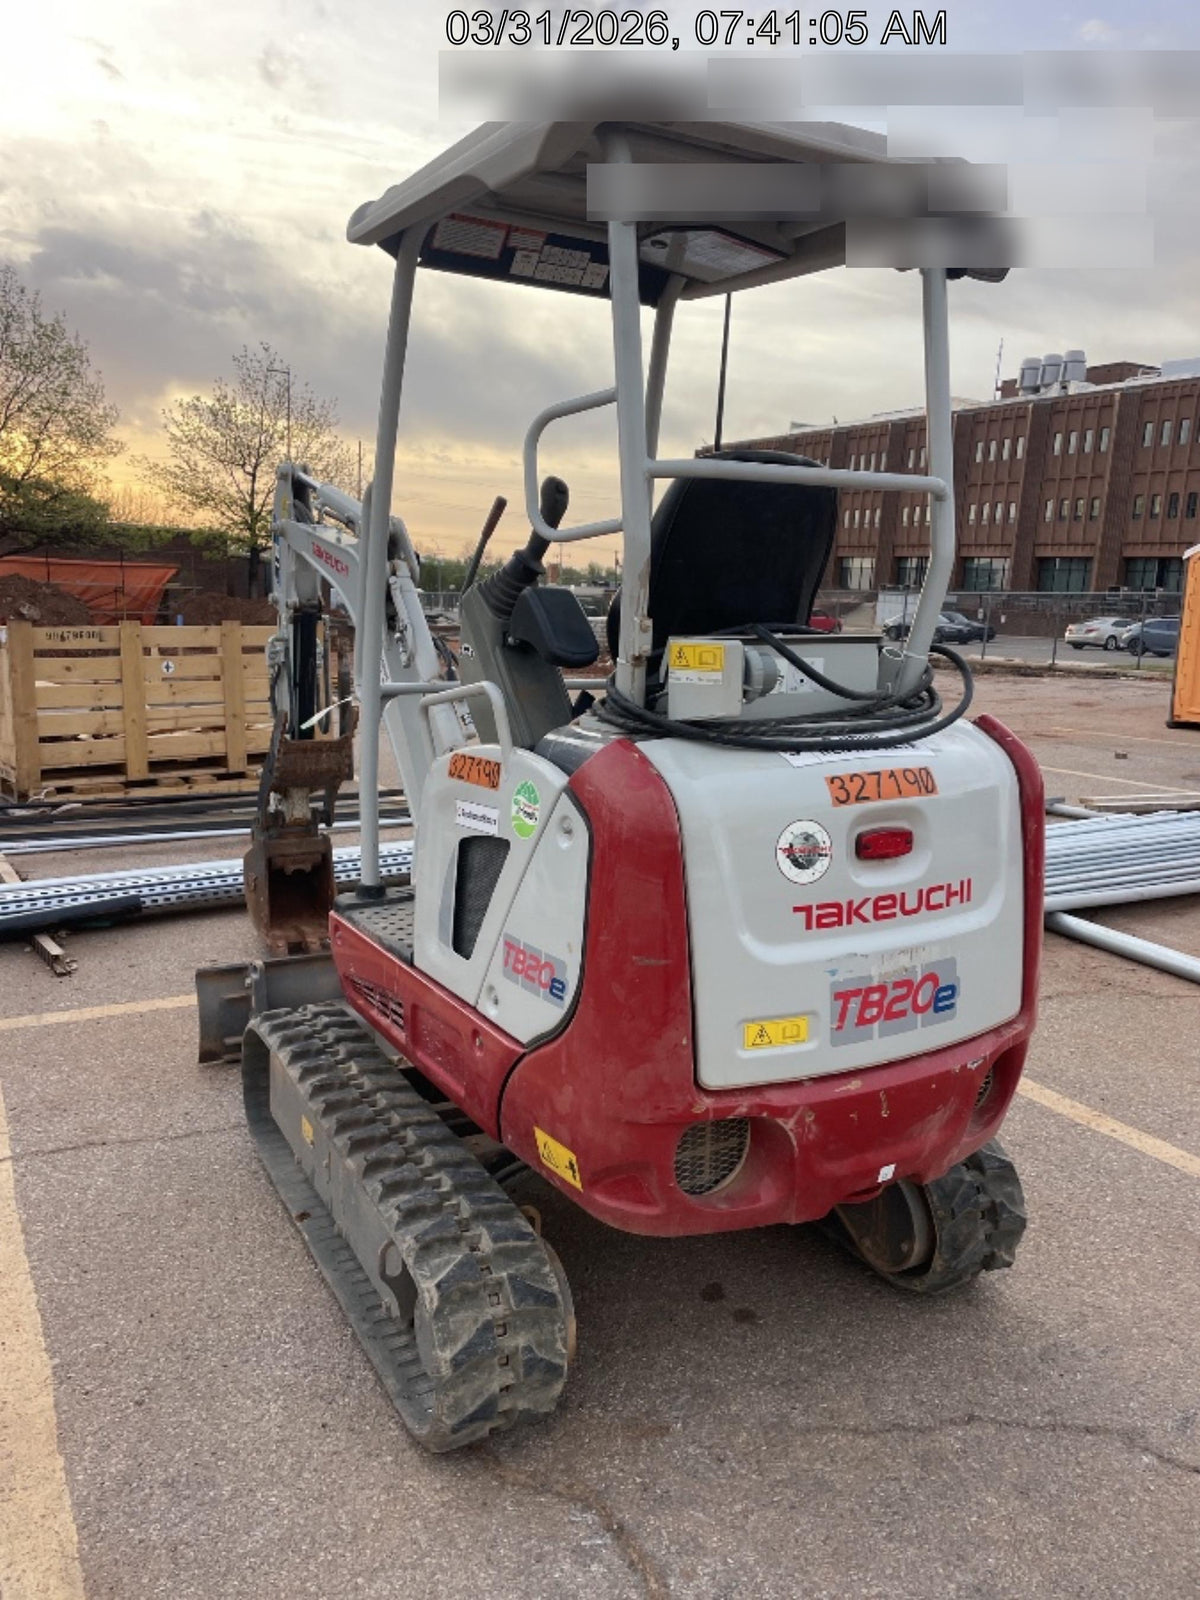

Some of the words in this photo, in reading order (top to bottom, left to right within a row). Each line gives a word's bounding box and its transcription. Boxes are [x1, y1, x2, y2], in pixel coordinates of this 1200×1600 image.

[448, 753, 501, 789] 327190
[829, 766, 936, 804] 327190
[792, 877, 973, 931] TAKEUCHI
[503, 939, 566, 1001] TB20e
[833, 971, 958, 1031] TB20e
